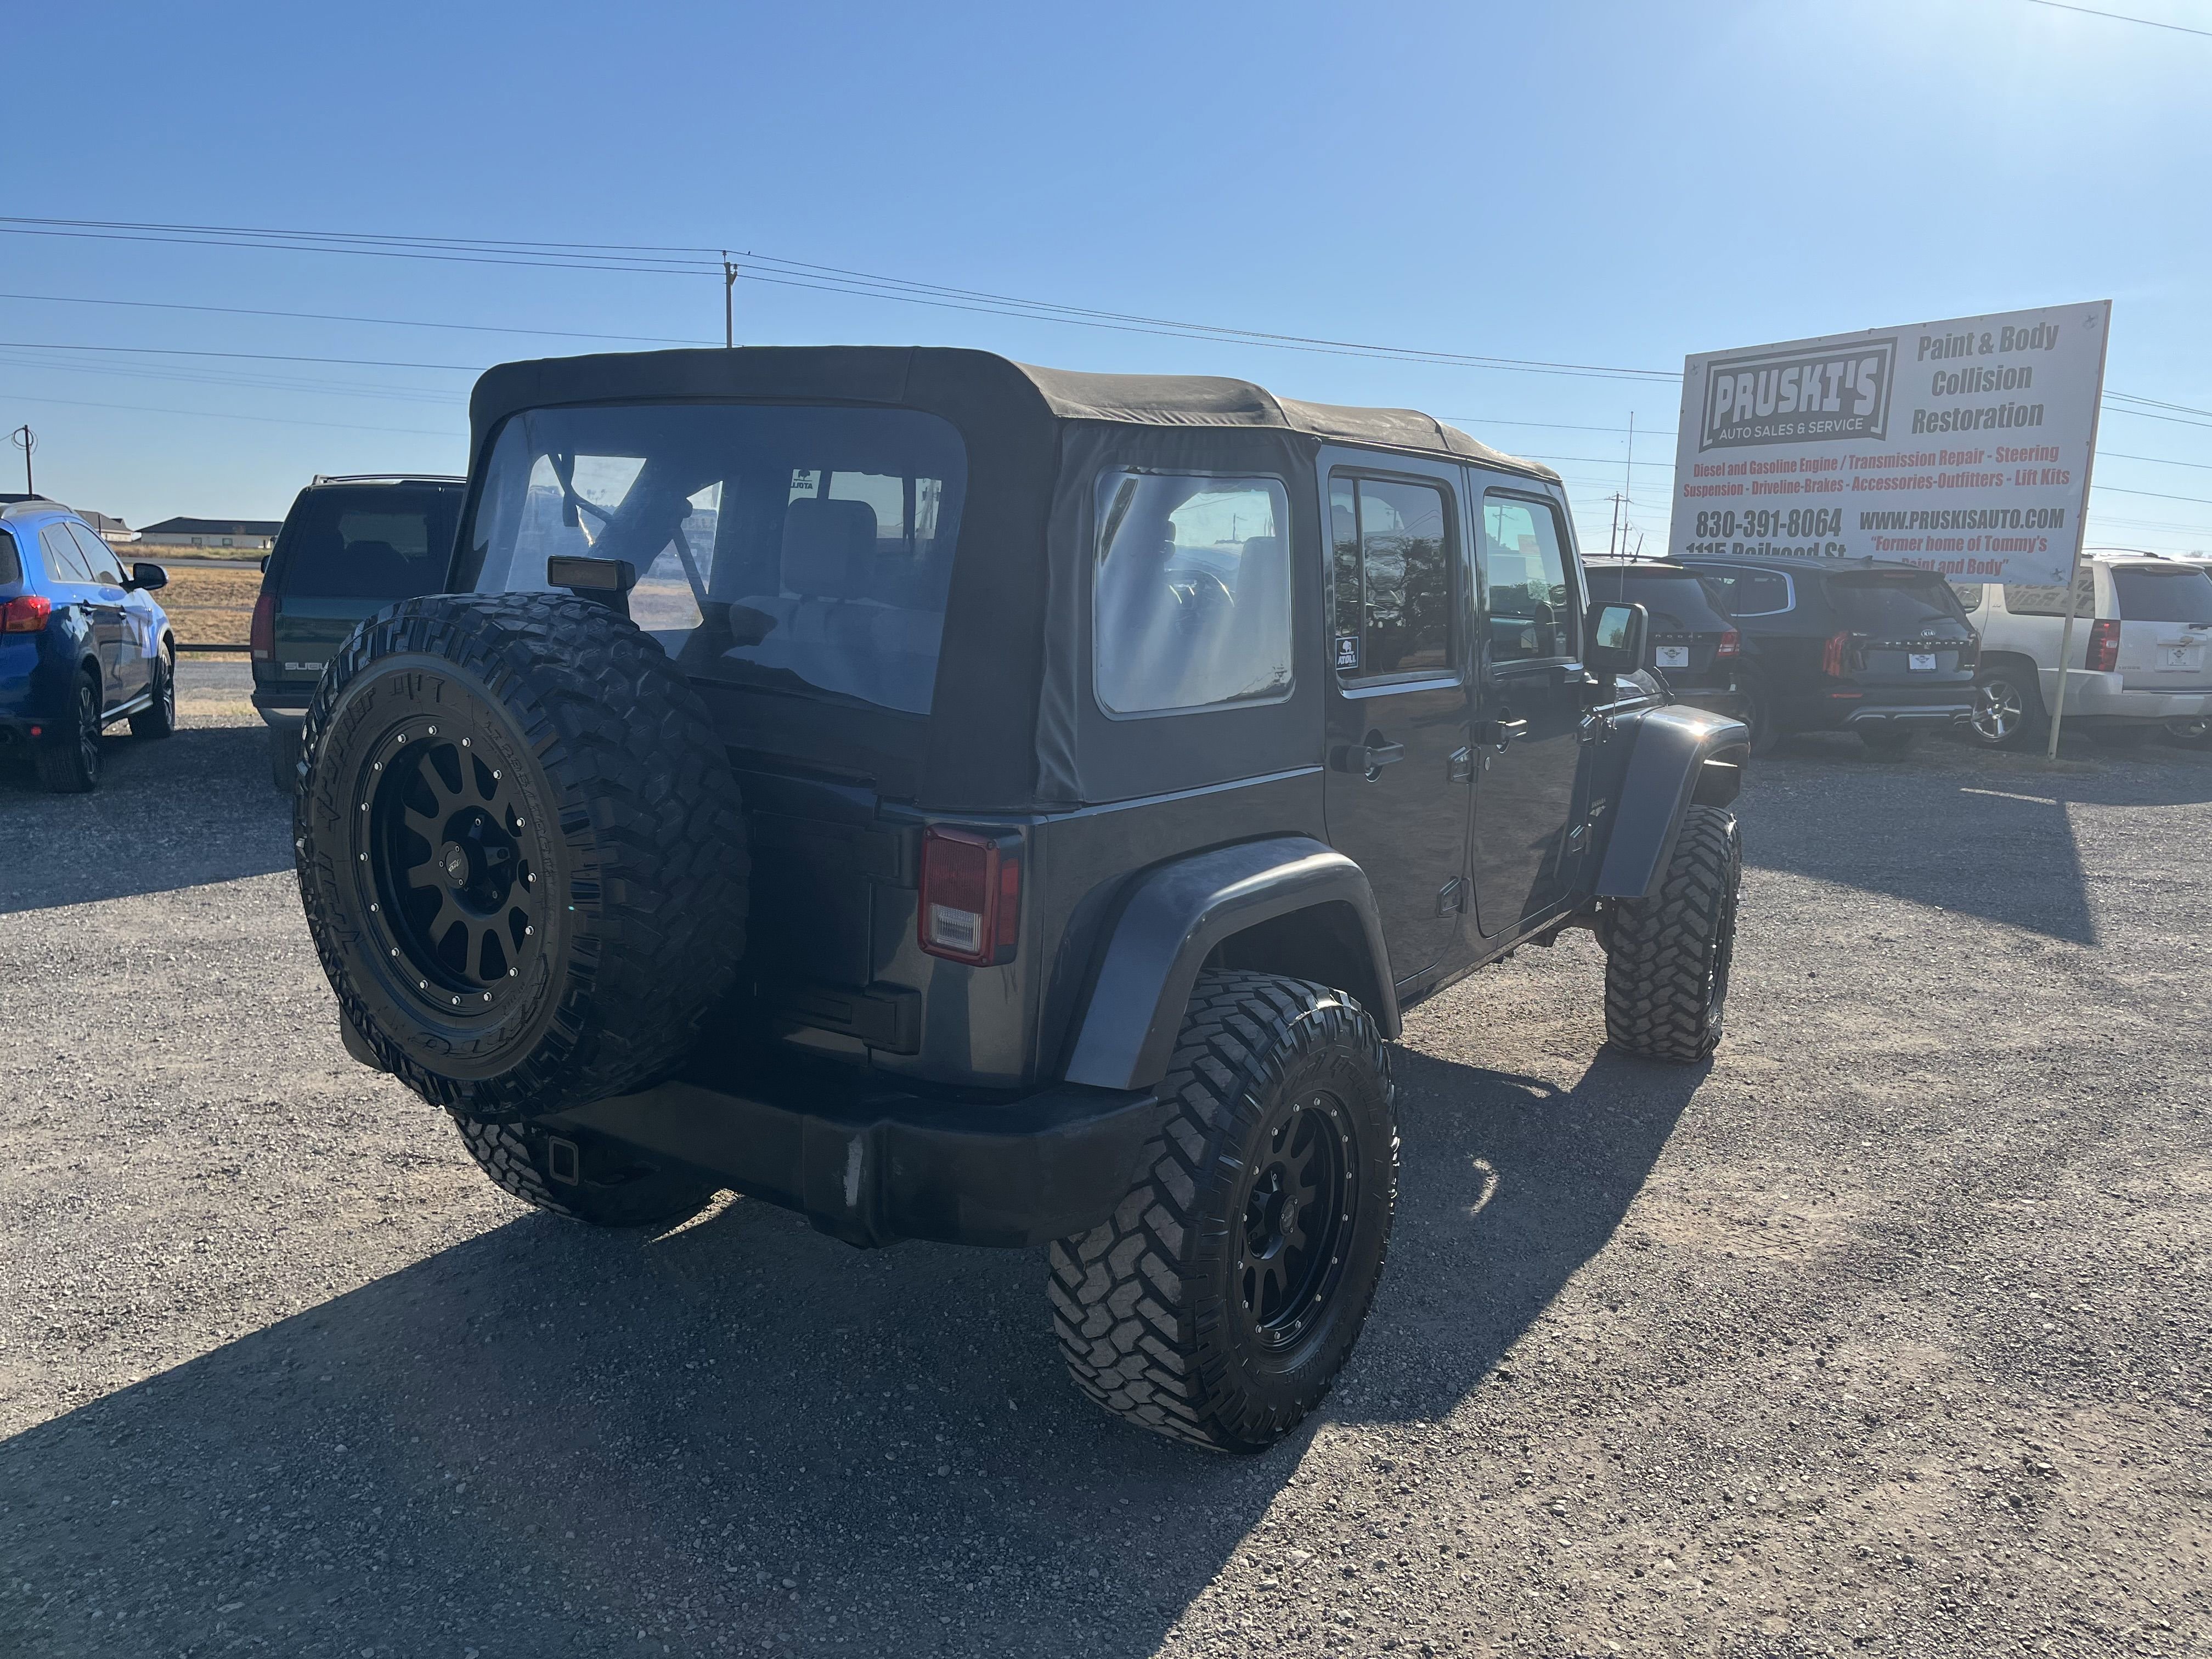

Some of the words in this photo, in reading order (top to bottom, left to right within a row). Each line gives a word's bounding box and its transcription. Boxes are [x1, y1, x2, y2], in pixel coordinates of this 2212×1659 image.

[1917, 332, 1974, 362] Paint
[1978, 332, 1994, 355] &
[1999, 322, 2059, 353] Body
[1713, 357, 1878, 430] PRUSKI'S
[1932, 365, 2032, 396] Collision
[1719, 426, 1751, 440] AUTO
[1754, 424, 1794, 437] SALES
[1797, 423, 1805, 435] &
[1809, 418, 1864, 433] SERVICE
[1911, 402, 2044, 434] Restoration
[1694, 462, 1725, 477] Diesel
[1728, 461, 1747, 476] and
[1750, 459, 1797, 475] Gasoline
[1799, 457, 1838, 473] Engine
[1840, 455, 1847, 471] /
[1849, 452, 1936, 470] Transmission
[1939, 448, 1985, 466] Repair
[1995, 444, 2059, 463] Steering
[1684, 482, 1743, 498] Suspension
[2015, 469, 2038, 486] Lift
[2040, 468, 2070, 486] Kits
[1696, 508, 1842, 538] 830-391-8064
[1860, 509, 2065, 531] WWW.PRUSKISAUTO.COM
[1871, 535, 1923, 551] "Former
[1925, 535, 1964, 551] home
[1968, 535, 1983, 551] of
[1985, 535, 2047, 554] Tommy's
[1938, 558, 1965, 574] and
[1966, 558, 2009, 576] Body"
[1338, 654, 1356, 665] ATOLL
